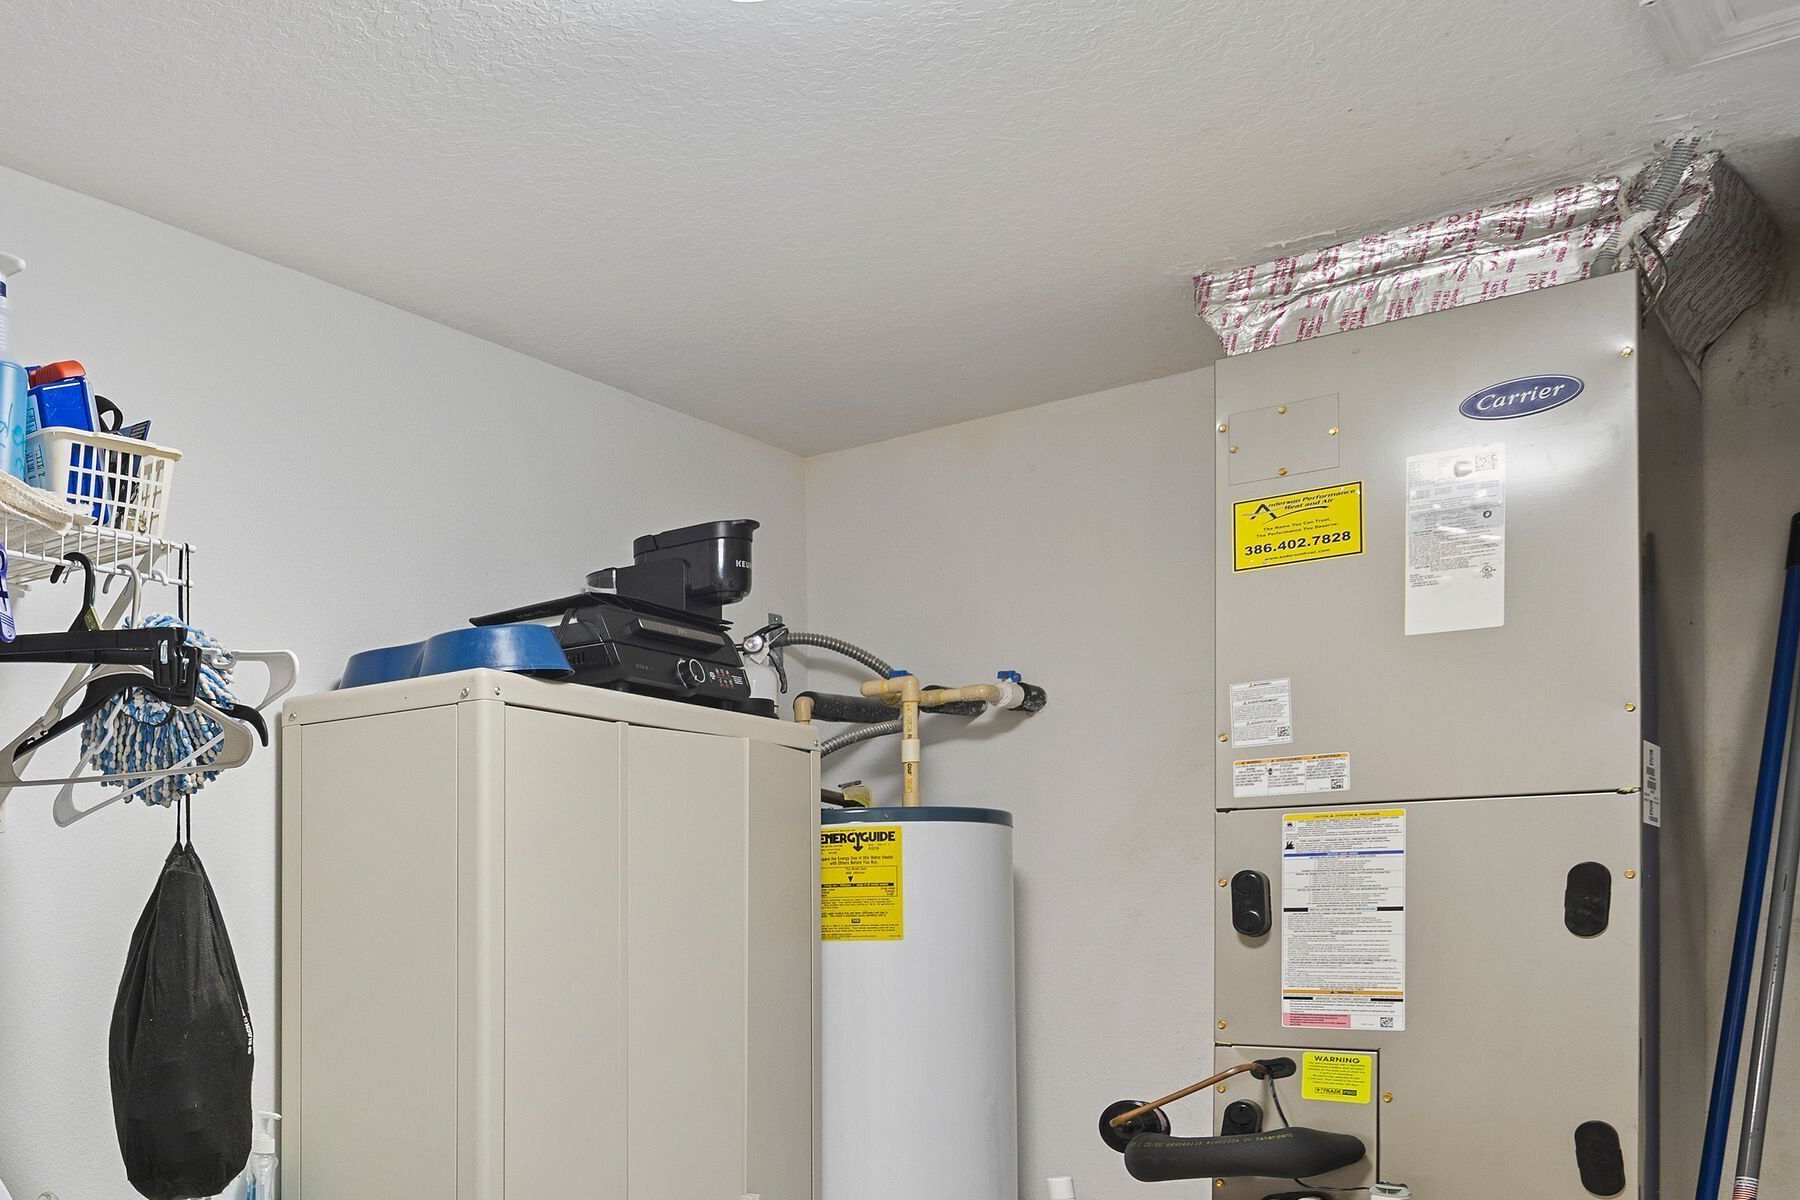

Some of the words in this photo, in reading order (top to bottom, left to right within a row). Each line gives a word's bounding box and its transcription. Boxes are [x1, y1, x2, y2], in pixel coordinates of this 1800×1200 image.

[1476, 383, 1566, 411] Carrier
[1302, 489, 1356, 502] Performance
[1284, 502, 1304, 511] Heat
[1304, 500, 1320, 508] and
[1244, 530, 1352, 557] 386.402.7828
[821, 830, 896, 846] ENERGYGUIDE
[1314, 1055, 1360, 1064] WARNING
